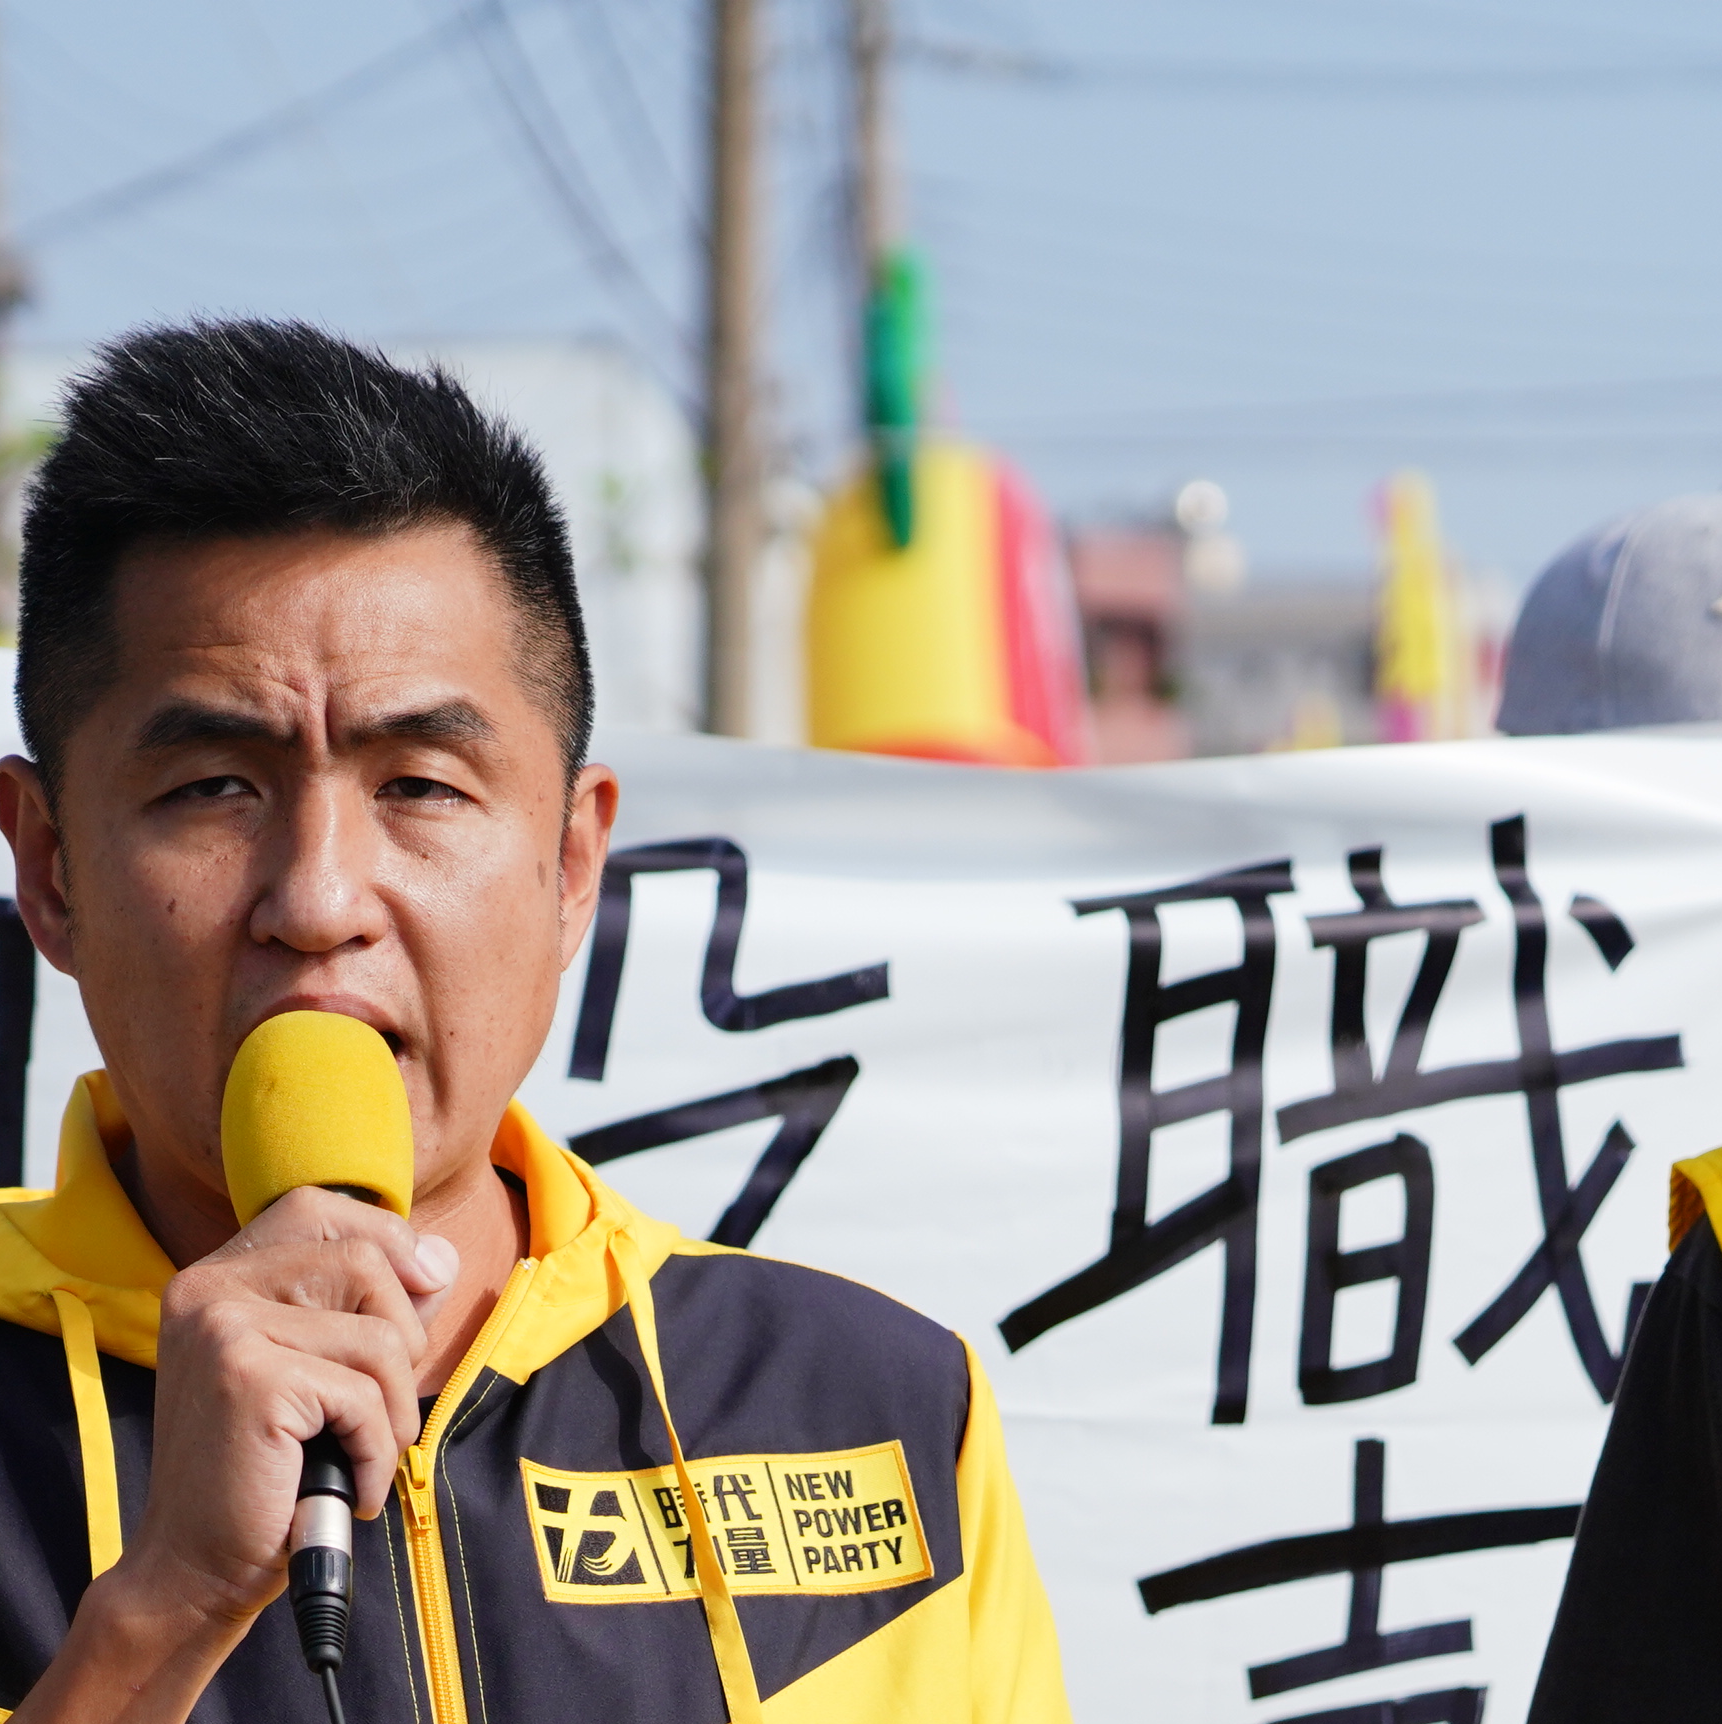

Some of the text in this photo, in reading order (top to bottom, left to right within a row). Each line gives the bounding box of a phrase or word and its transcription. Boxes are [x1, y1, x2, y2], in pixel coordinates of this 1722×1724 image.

[785, 1470, 854, 1502] NEW
[794, 1499, 908, 1538] POWER
[804, 1536, 904, 1575] PARTY
